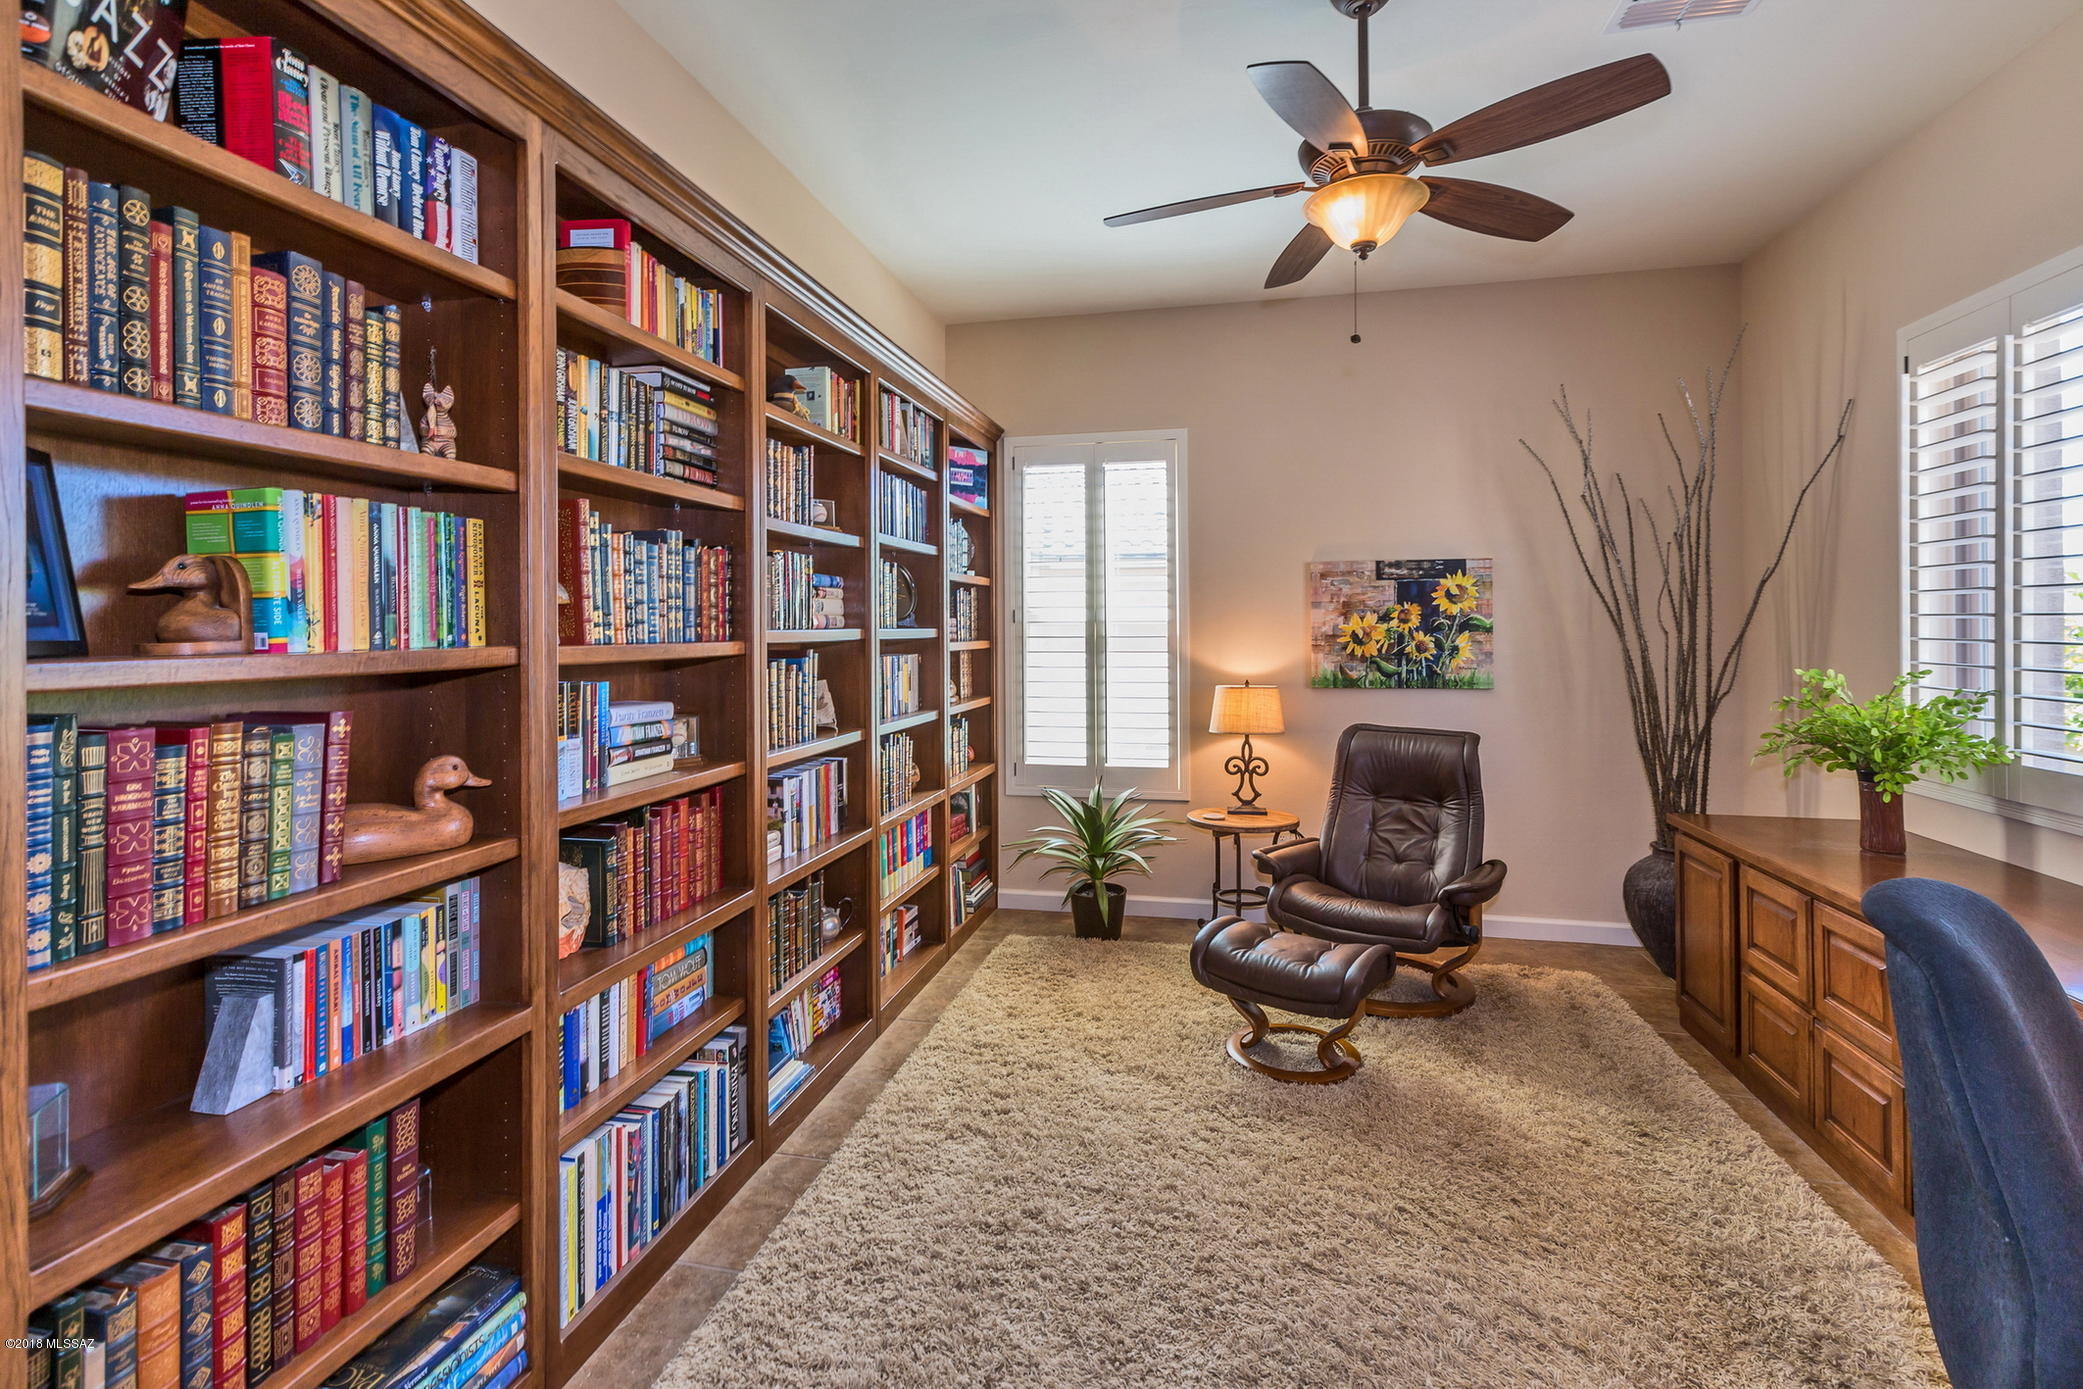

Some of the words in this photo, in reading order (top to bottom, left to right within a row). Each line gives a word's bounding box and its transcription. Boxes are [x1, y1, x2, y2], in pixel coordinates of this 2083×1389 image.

[90, 0, 174, 92] AZZ
[375, 130, 391, 166] Without
[410, 127, 422, 148] Tom
[407, 148, 423, 183] Clancy
[352, 182, 363, 211] Fear
[375, 165, 392, 207] Remorse
[412, 217, 425, 240] Hon
[471, 521, 480, 577] KINGSOLVER
[477, 523, 485, 577] BARBARA
[272, 607, 283, 625] SIDE
[473, 590, 481, 634] LACUNA
[730, 1064, 740, 1132] PAINTING
[373, 1162, 384, 1193] DON
[373, 1196, 384, 1235] JUAN
